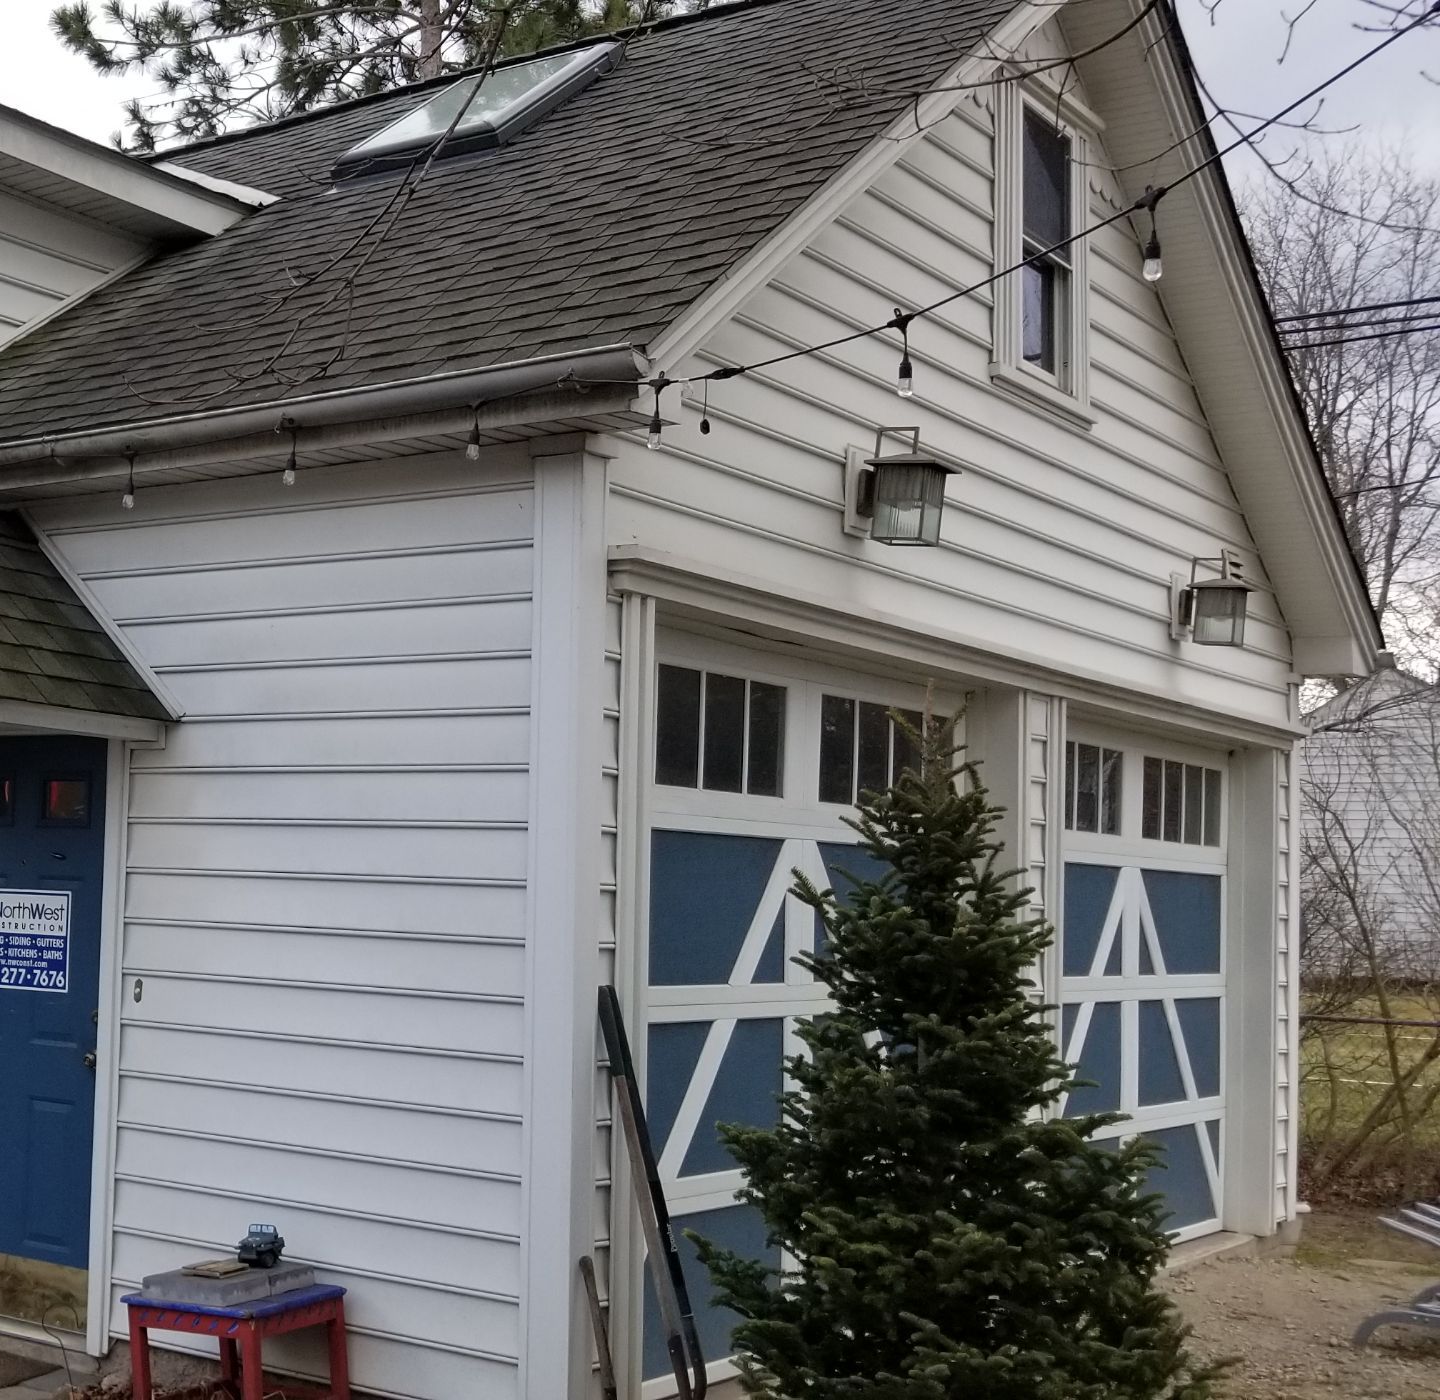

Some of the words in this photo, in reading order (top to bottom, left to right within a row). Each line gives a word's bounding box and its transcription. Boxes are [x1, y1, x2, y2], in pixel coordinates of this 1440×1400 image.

[9, 936, 32, 946] SIDING
[36, 938, 64, 948] GUTTERS
[8, 948, 38, 958] KITCHENS
[42, 950, 63, 960] BATHS
